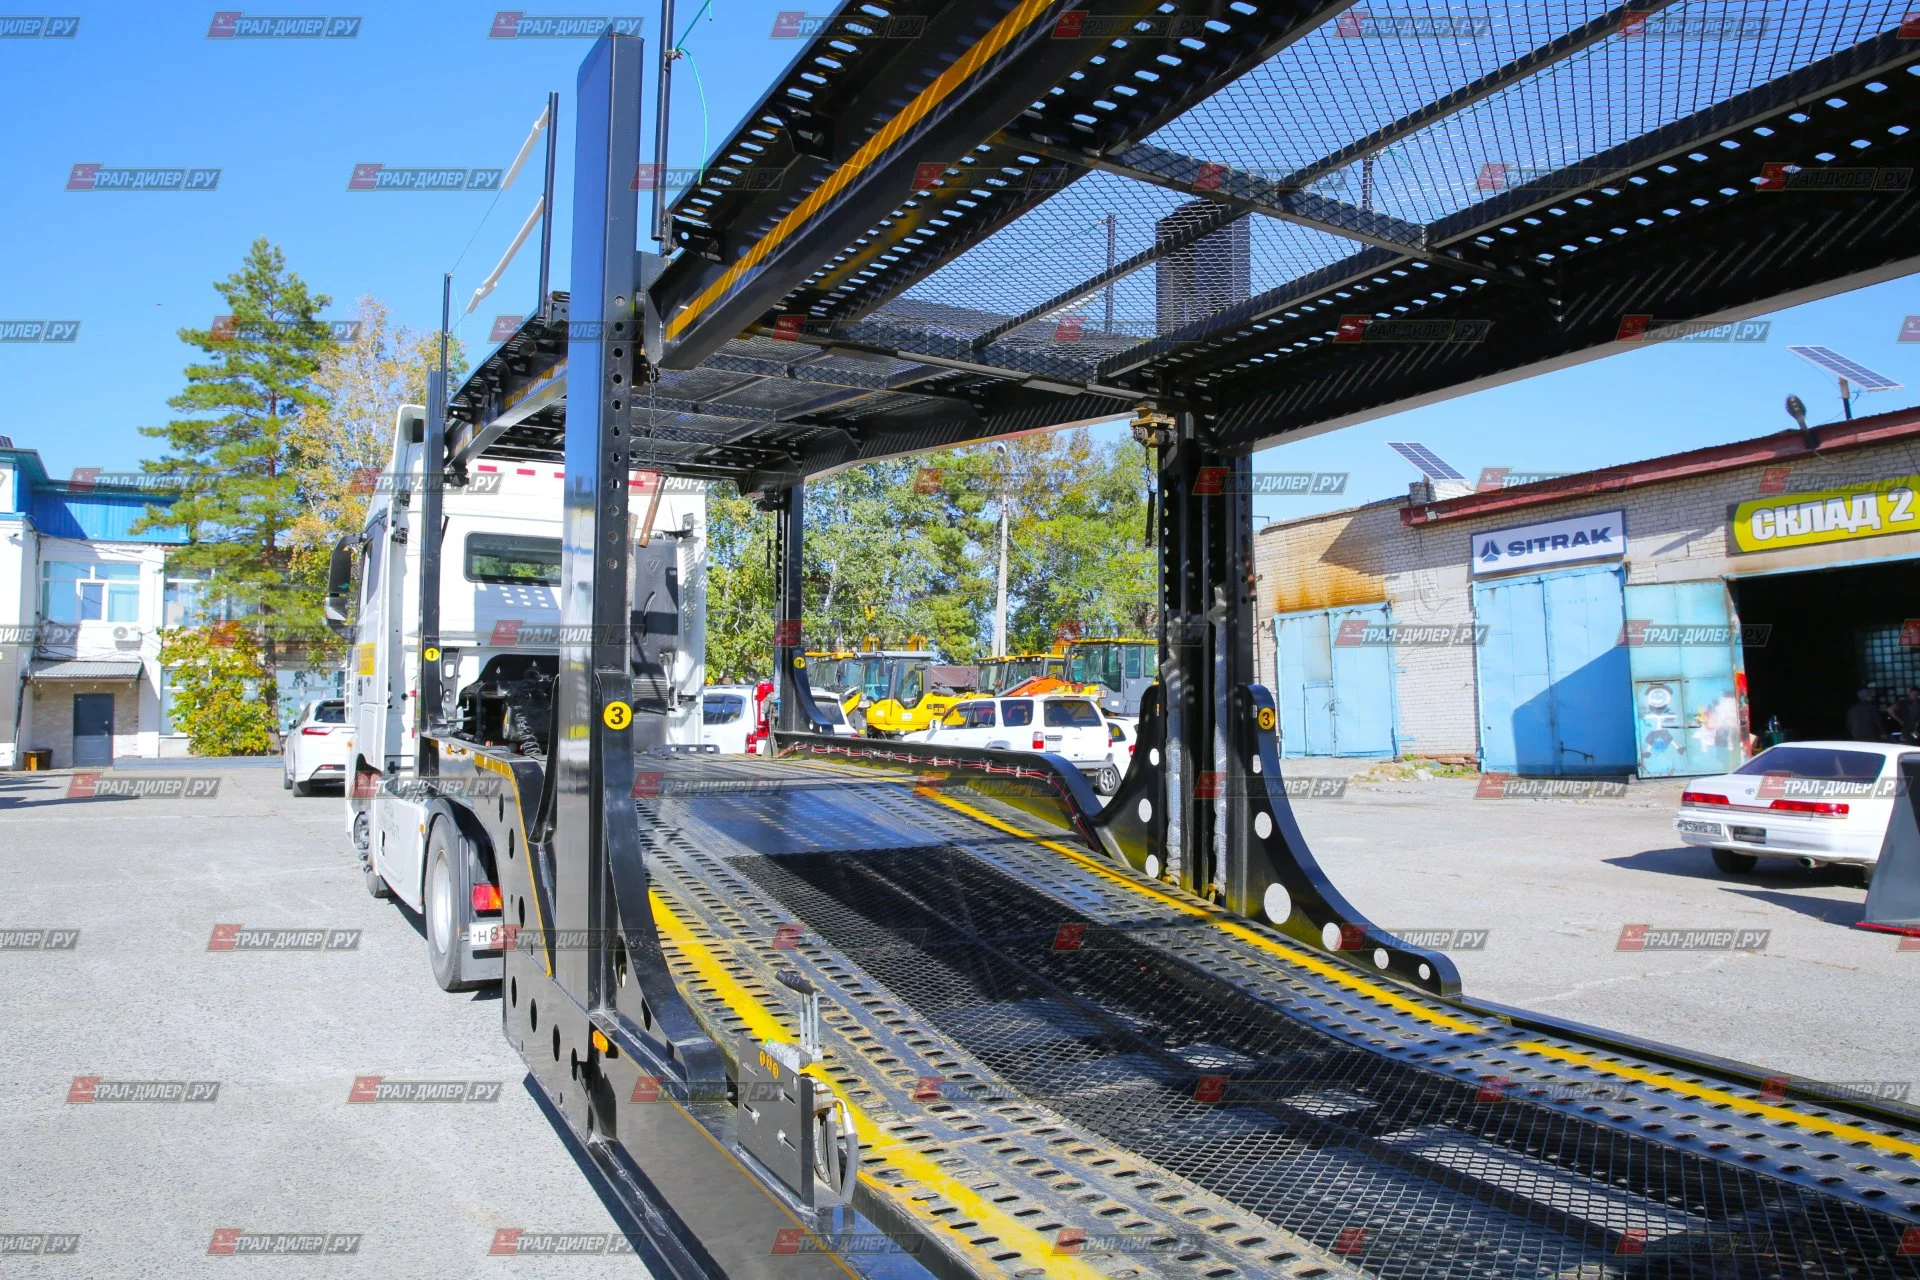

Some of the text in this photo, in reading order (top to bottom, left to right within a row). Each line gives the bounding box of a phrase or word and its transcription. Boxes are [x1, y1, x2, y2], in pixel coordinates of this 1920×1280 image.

[1751, 487, 1914, 541] СКЛАД 2
[1507, 526, 1612, 557] SITRAK
[610, 706, 624, 725] 3
